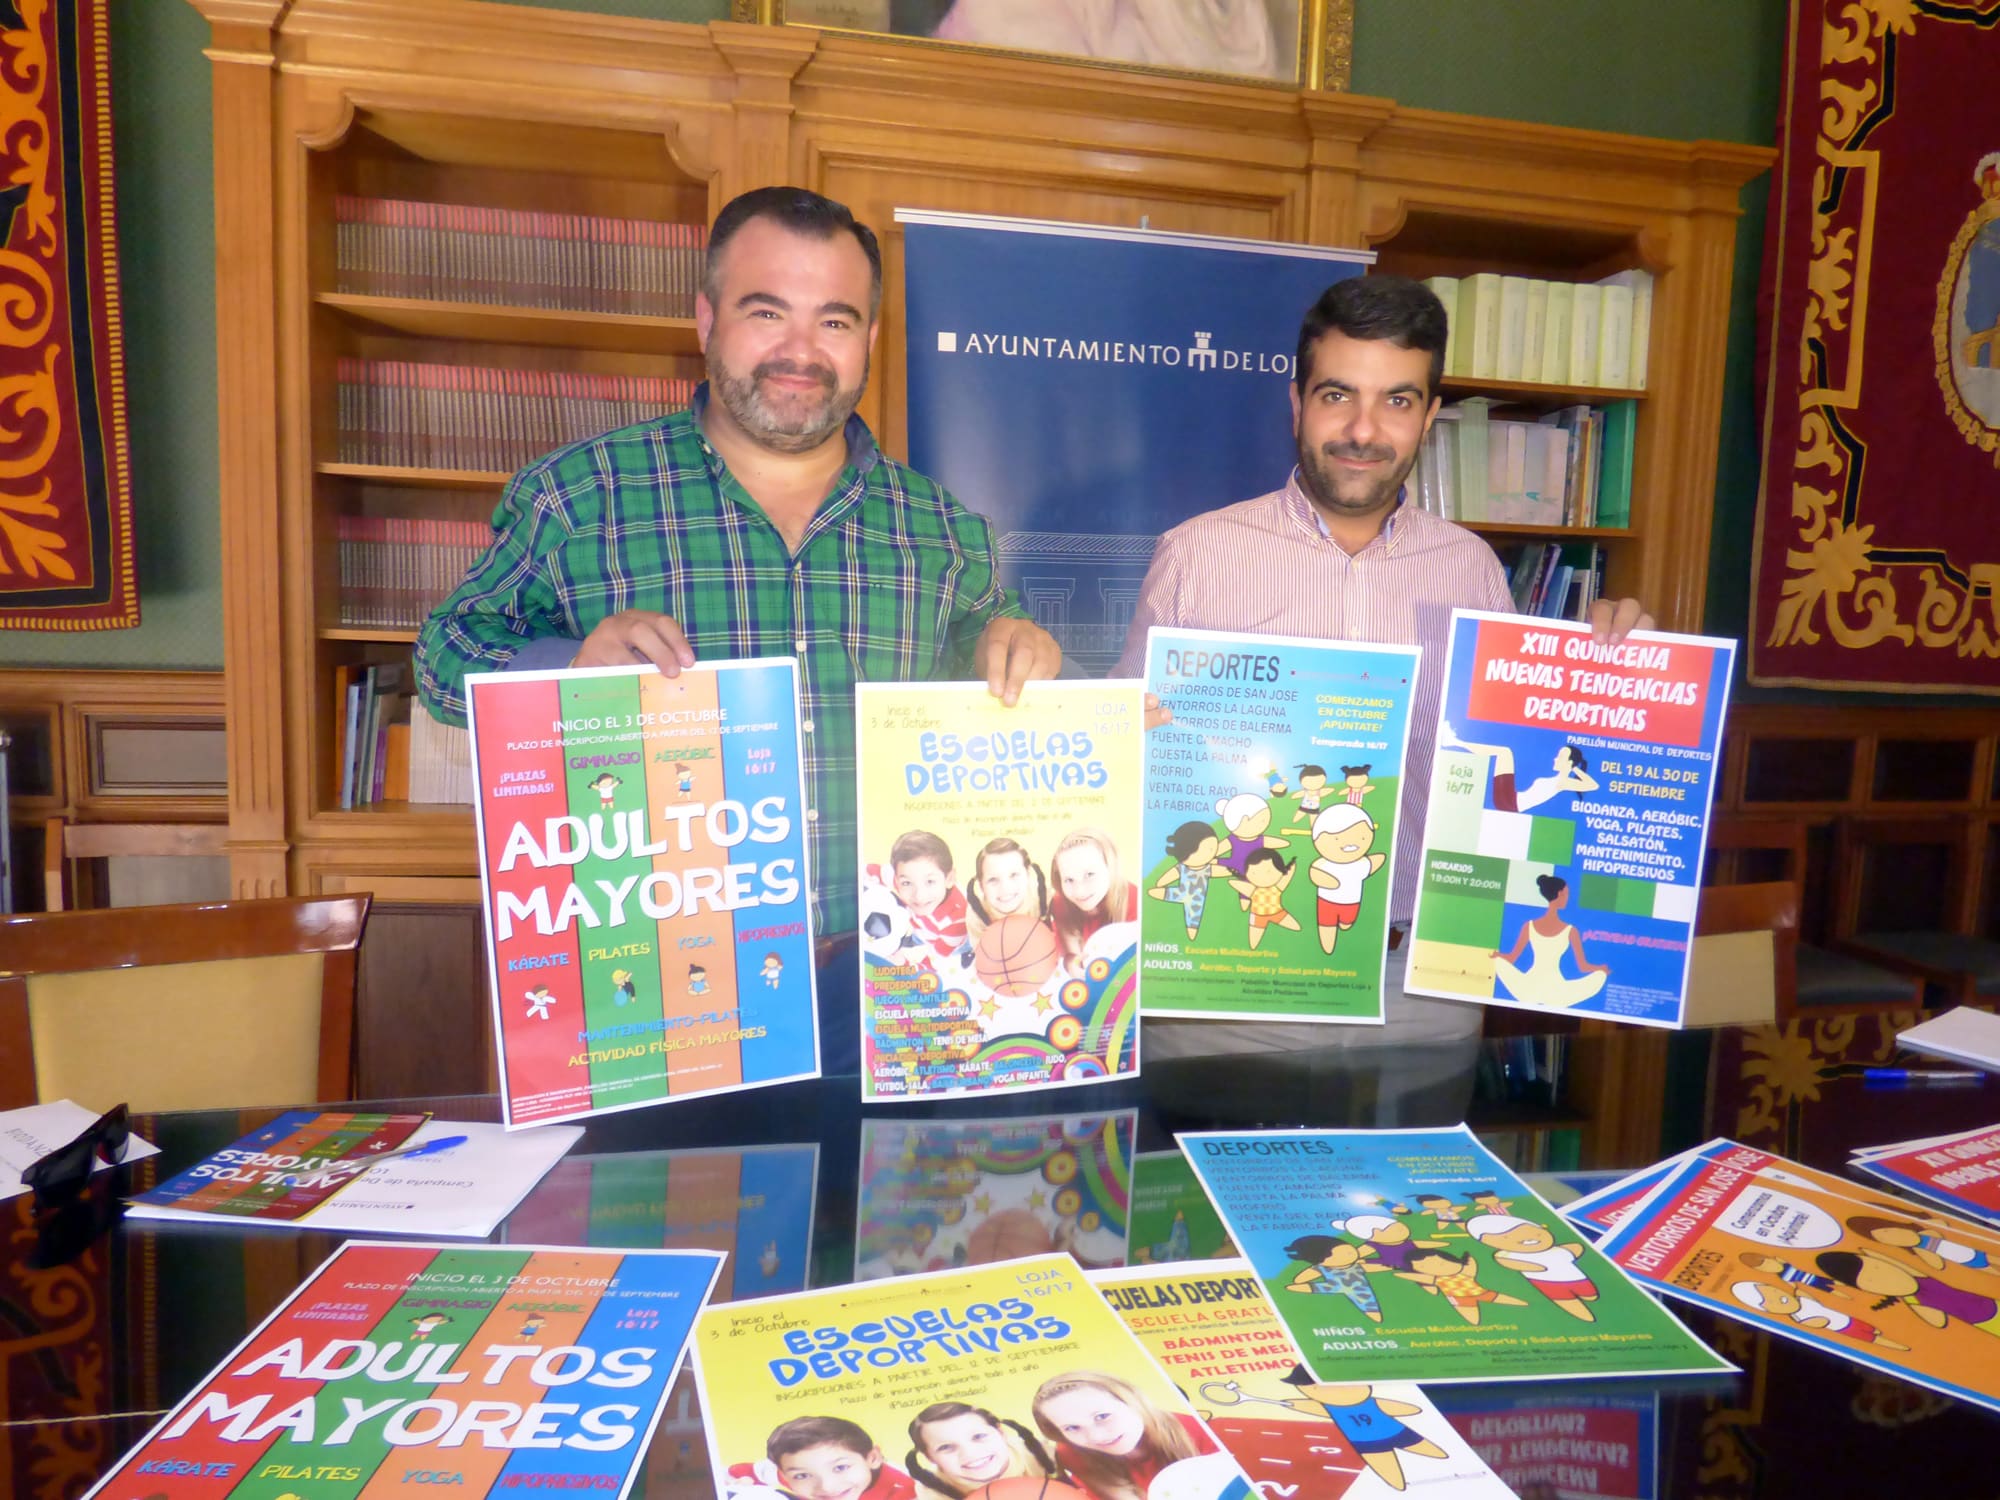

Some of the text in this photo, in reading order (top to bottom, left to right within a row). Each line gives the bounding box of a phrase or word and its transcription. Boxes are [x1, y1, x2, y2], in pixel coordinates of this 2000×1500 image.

[964, 332, 1298, 379] AYUNTAMIENTO DE LOJ
[1519, 632, 1671, 671] XIII QUINCENA
[1166, 649, 1281, 682] DEPORTES
[1155, 682, 1224, 697] VENTORROS
[1227, 687, 1241, 698] DE
[1244, 688, 1266, 699] SAN
[1485, 658, 1698, 705] NUEVAS TENDENCIAS
[1094, 702, 1129, 716] LOJA
[1224, 703, 1238, 714] LA
[1241, 704, 1287, 717] LAGUNA
[1316, 694, 1394, 709] COMENZAMOS
[552, 708, 728, 733] INICIO EL 3 DE OCTUBRE
[883, 717, 896, 729] de
[1318, 707, 1388, 721] EN OCTUBRE
[1524, 696, 1648, 732] DEPORTIVAS
[1093, 721, 1131, 736] 16/17
[1222, 718, 1237, 730] DE
[1240, 721, 1292, 734] BALERMA
[507, 741, 538, 751] PLAZO
[540, 740, 553, 749] DE
[919, 730, 1094, 763] ESCUELAS
[1151, 732, 1193, 745] FUENTE
[1567, 735, 1713, 761] PABELLÓN MUNICIPAL DE DEPORTES
[569, 752, 641, 769] GIMNASIO
[1151, 748, 1193, 761] CUESTA
[1195, 751, 1209, 762] LA
[905, 760, 1108, 796] DEPORTIVAS
[1601, 760, 1623, 775] DEL
[1626, 763, 1643, 776] 19
[1644, 766, 1660, 779] AL
[1682, 770, 1700, 784] DE
[1149, 782, 1183, 793] VENTA
[1186, 784, 1206, 796] DEL
[1609, 780, 1686, 801] SEPTIEMBRE
[1147, 799, 1161, 810] LA
[497, 797, 791, 873] ADULTOS
[1583, 858, 1675, 881] HIPOPRESIVOS
[497, 858, 802, 942] MAYORES
[588, 942, 651, 962] PILATES
[676, 934, 716, 951] YOGA
[508, 952, 571, 972] KÁRATE
[568, 1025, 767, 1068] ACTIVIDAD FÍSICA MAYORES
[1203, 1140, 1335, 1157] DEPORTES
[1709, 1165, 1744, 1190] JOSÉ
[1692, 1183, 1724, 1208] SAN
[1684, 1199, 1709, 1221] DE
[1730, 1191, 1773, 1230] Comenzamos
[1755, 1203, 1790, 1238] en Octubre
[1624, 1212, 1696, 1273] VENTORROS
[1014, 1267, 1064, 1285] LOJA
[1672, 1249, 1724, 1291] DEPORTES
[406, 1273, 622, 1288] INICIO EL 3 DE OCTUBRE
[1023, 1280, 1074, 1299] 16/17
[711, 1318, 811, 1340] 3 de Octubre
[731, 1312, 785, 1327] Inicio el
[782, 1297, 1036, 1357] ESCUELAS
[1163, 1329, 1284, 1349] BÁDMINTON
[767, 1315, 1073, 1388] DEPORTIVAS
[1161, 1350, 1215, 1365] TENIS
[1220, 1347, 1249, 1359] DE
[230, 1337, 661, 1388] ADULTOS
[1189, 1358, 1297, 1378] ATLETISMO
[158, 1392, 644, 1452] MAYORES
[1348, 1413, 1373, 1428] 19
[136, 1457, 237, 1478] KÁRATE
[258, 1464, 361, 1482] PILATES
[401, 1469, 466, 1487] YOGA
